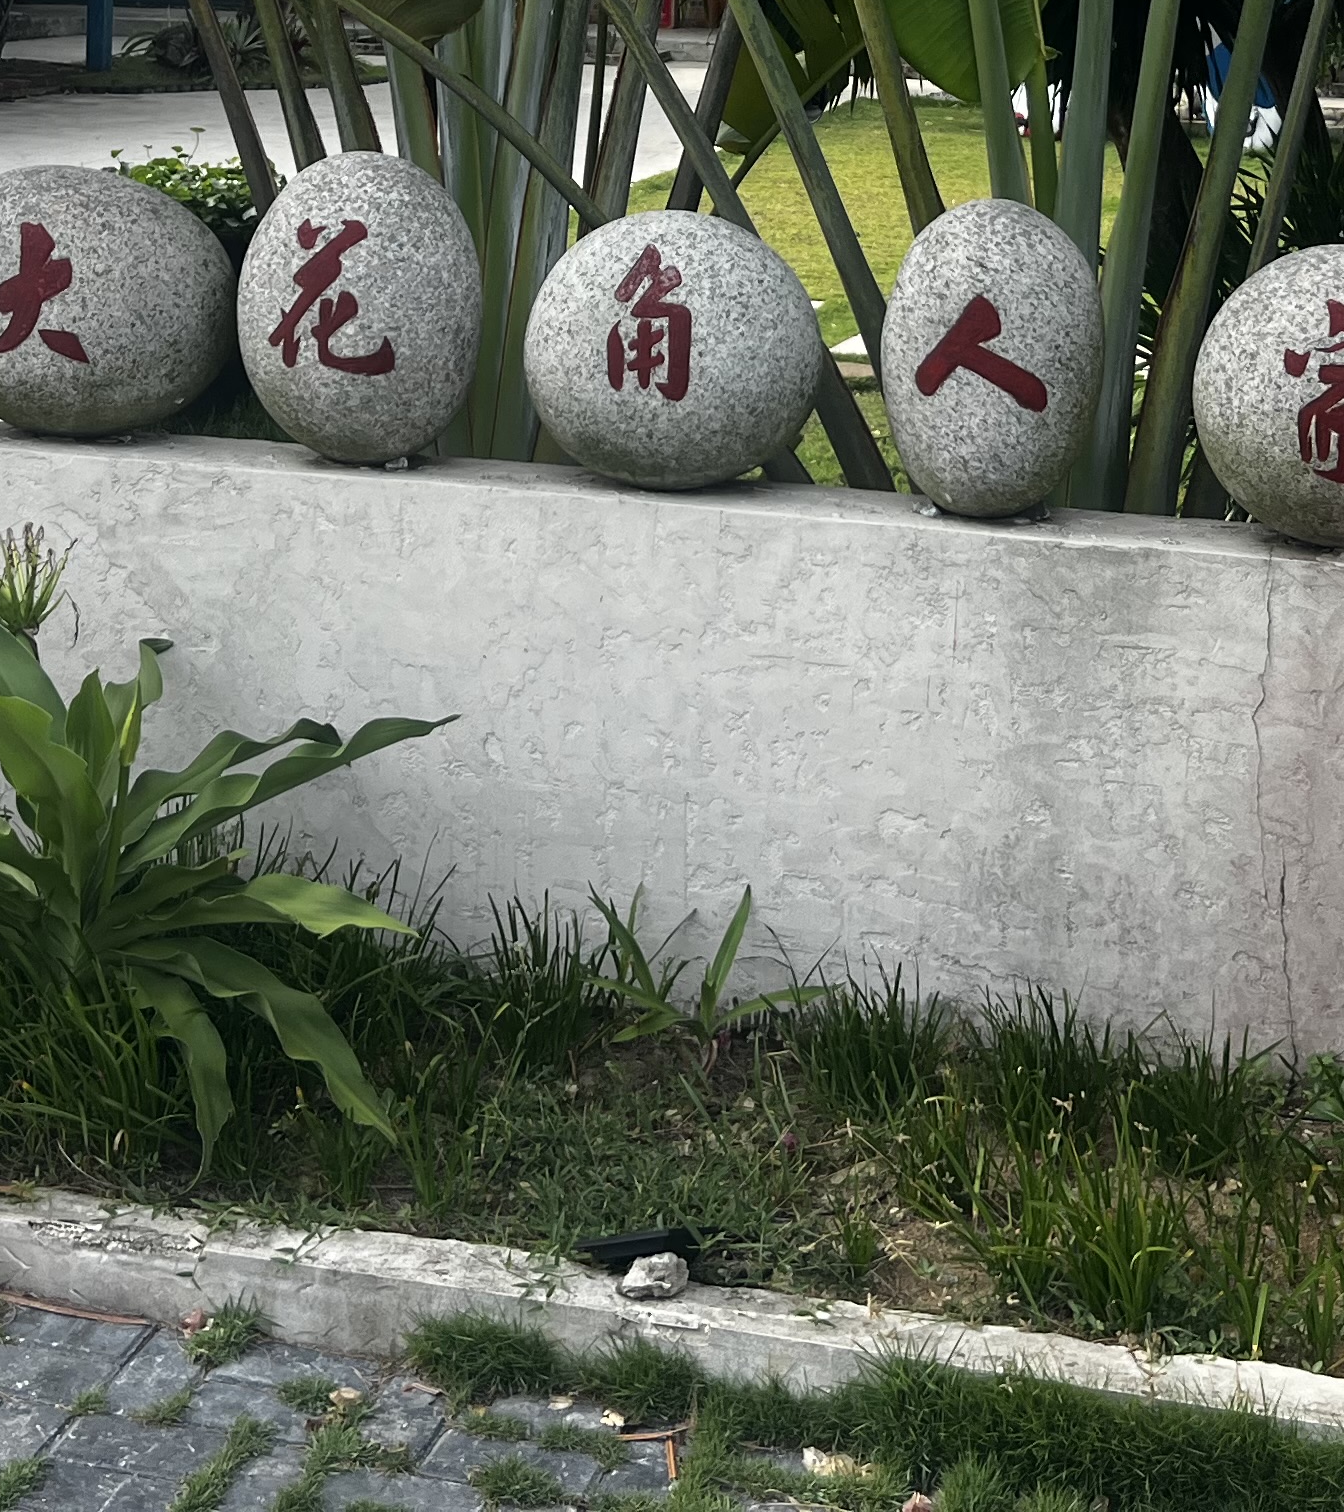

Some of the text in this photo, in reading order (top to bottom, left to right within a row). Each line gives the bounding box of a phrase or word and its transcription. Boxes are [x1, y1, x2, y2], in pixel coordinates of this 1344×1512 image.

[268, 217, 398, 377] 花
[608, 244, 692, 402] 角
[915, 291, 1049, 414] 人
